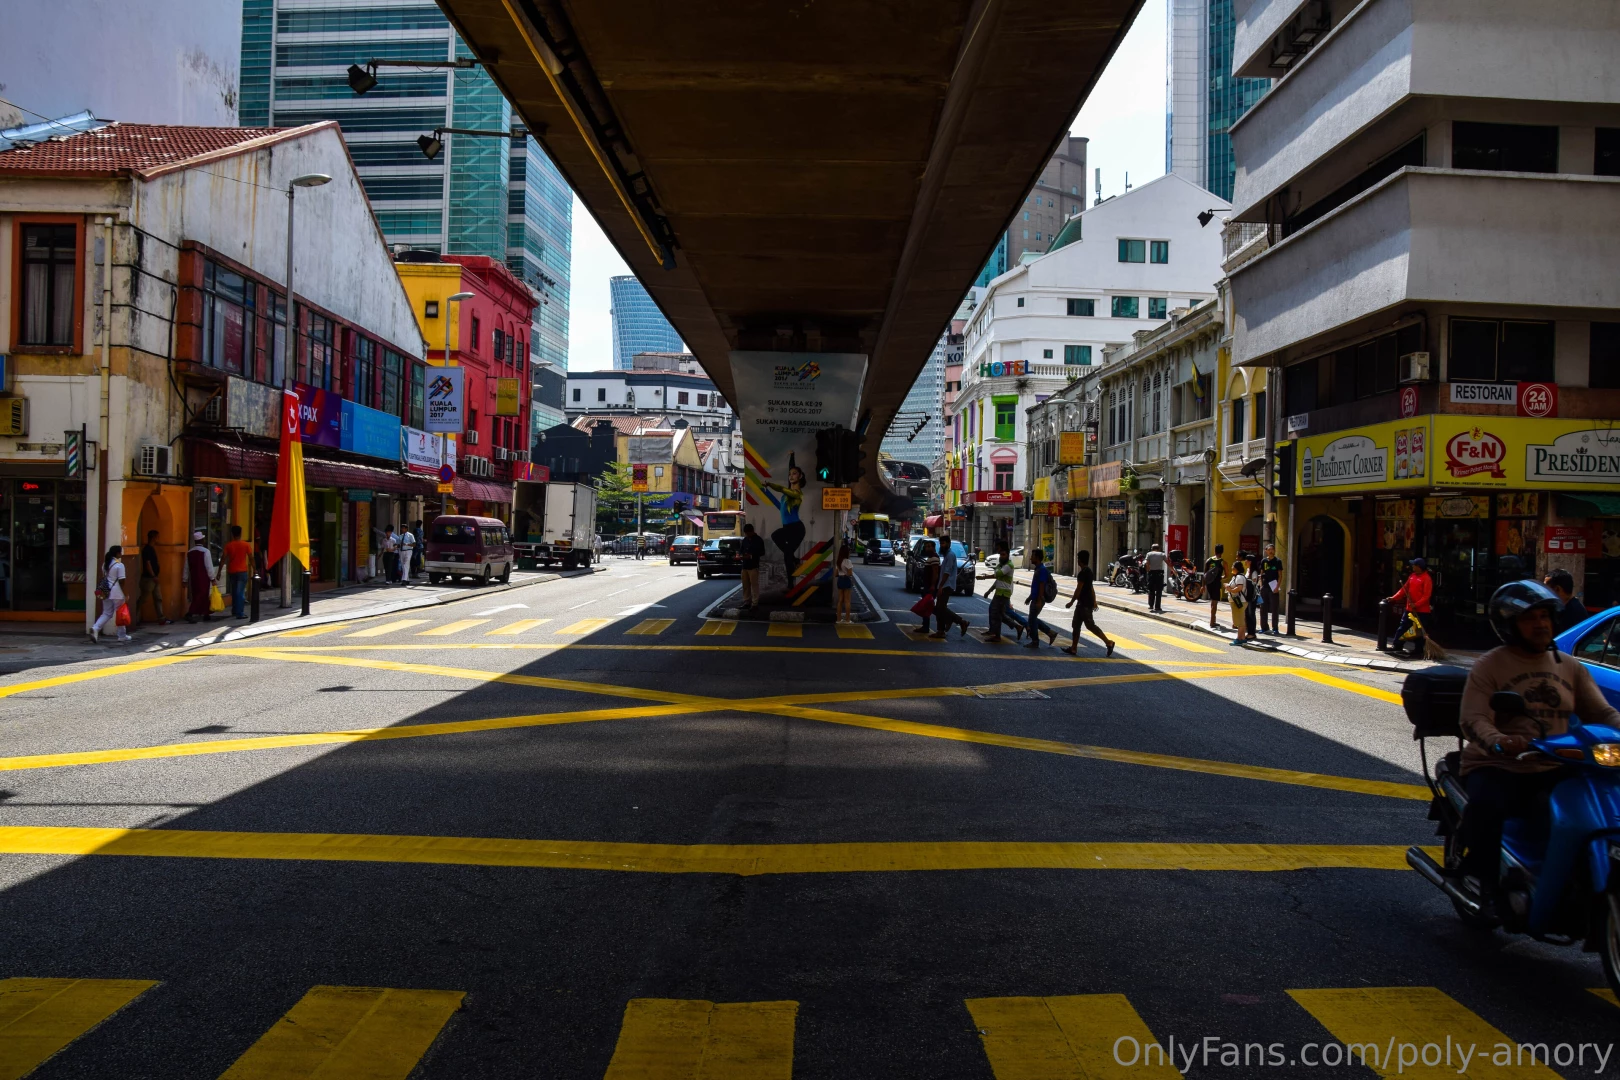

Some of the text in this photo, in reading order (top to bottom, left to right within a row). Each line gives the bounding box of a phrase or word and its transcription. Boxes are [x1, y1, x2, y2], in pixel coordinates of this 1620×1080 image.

[980, 359, 1034, 377] HOTEL
[498, 380, 518, 391] HOTEL
[1404, 393, 1413, 406] 24
[1455, 385, 1512, 401] RESTORAN
[1529, 391, 1546, 403] 24
[1404, 405, 1413, 413] JAM
[1529, 402, 1547, 411] JAM
[303, 405, 318, 423] PAX
[1457, 441, 1497, 459] F&N
[1316, 459, 1352, 481] PRESIDENT
[1353, 454, 1384, 475] CORNER
